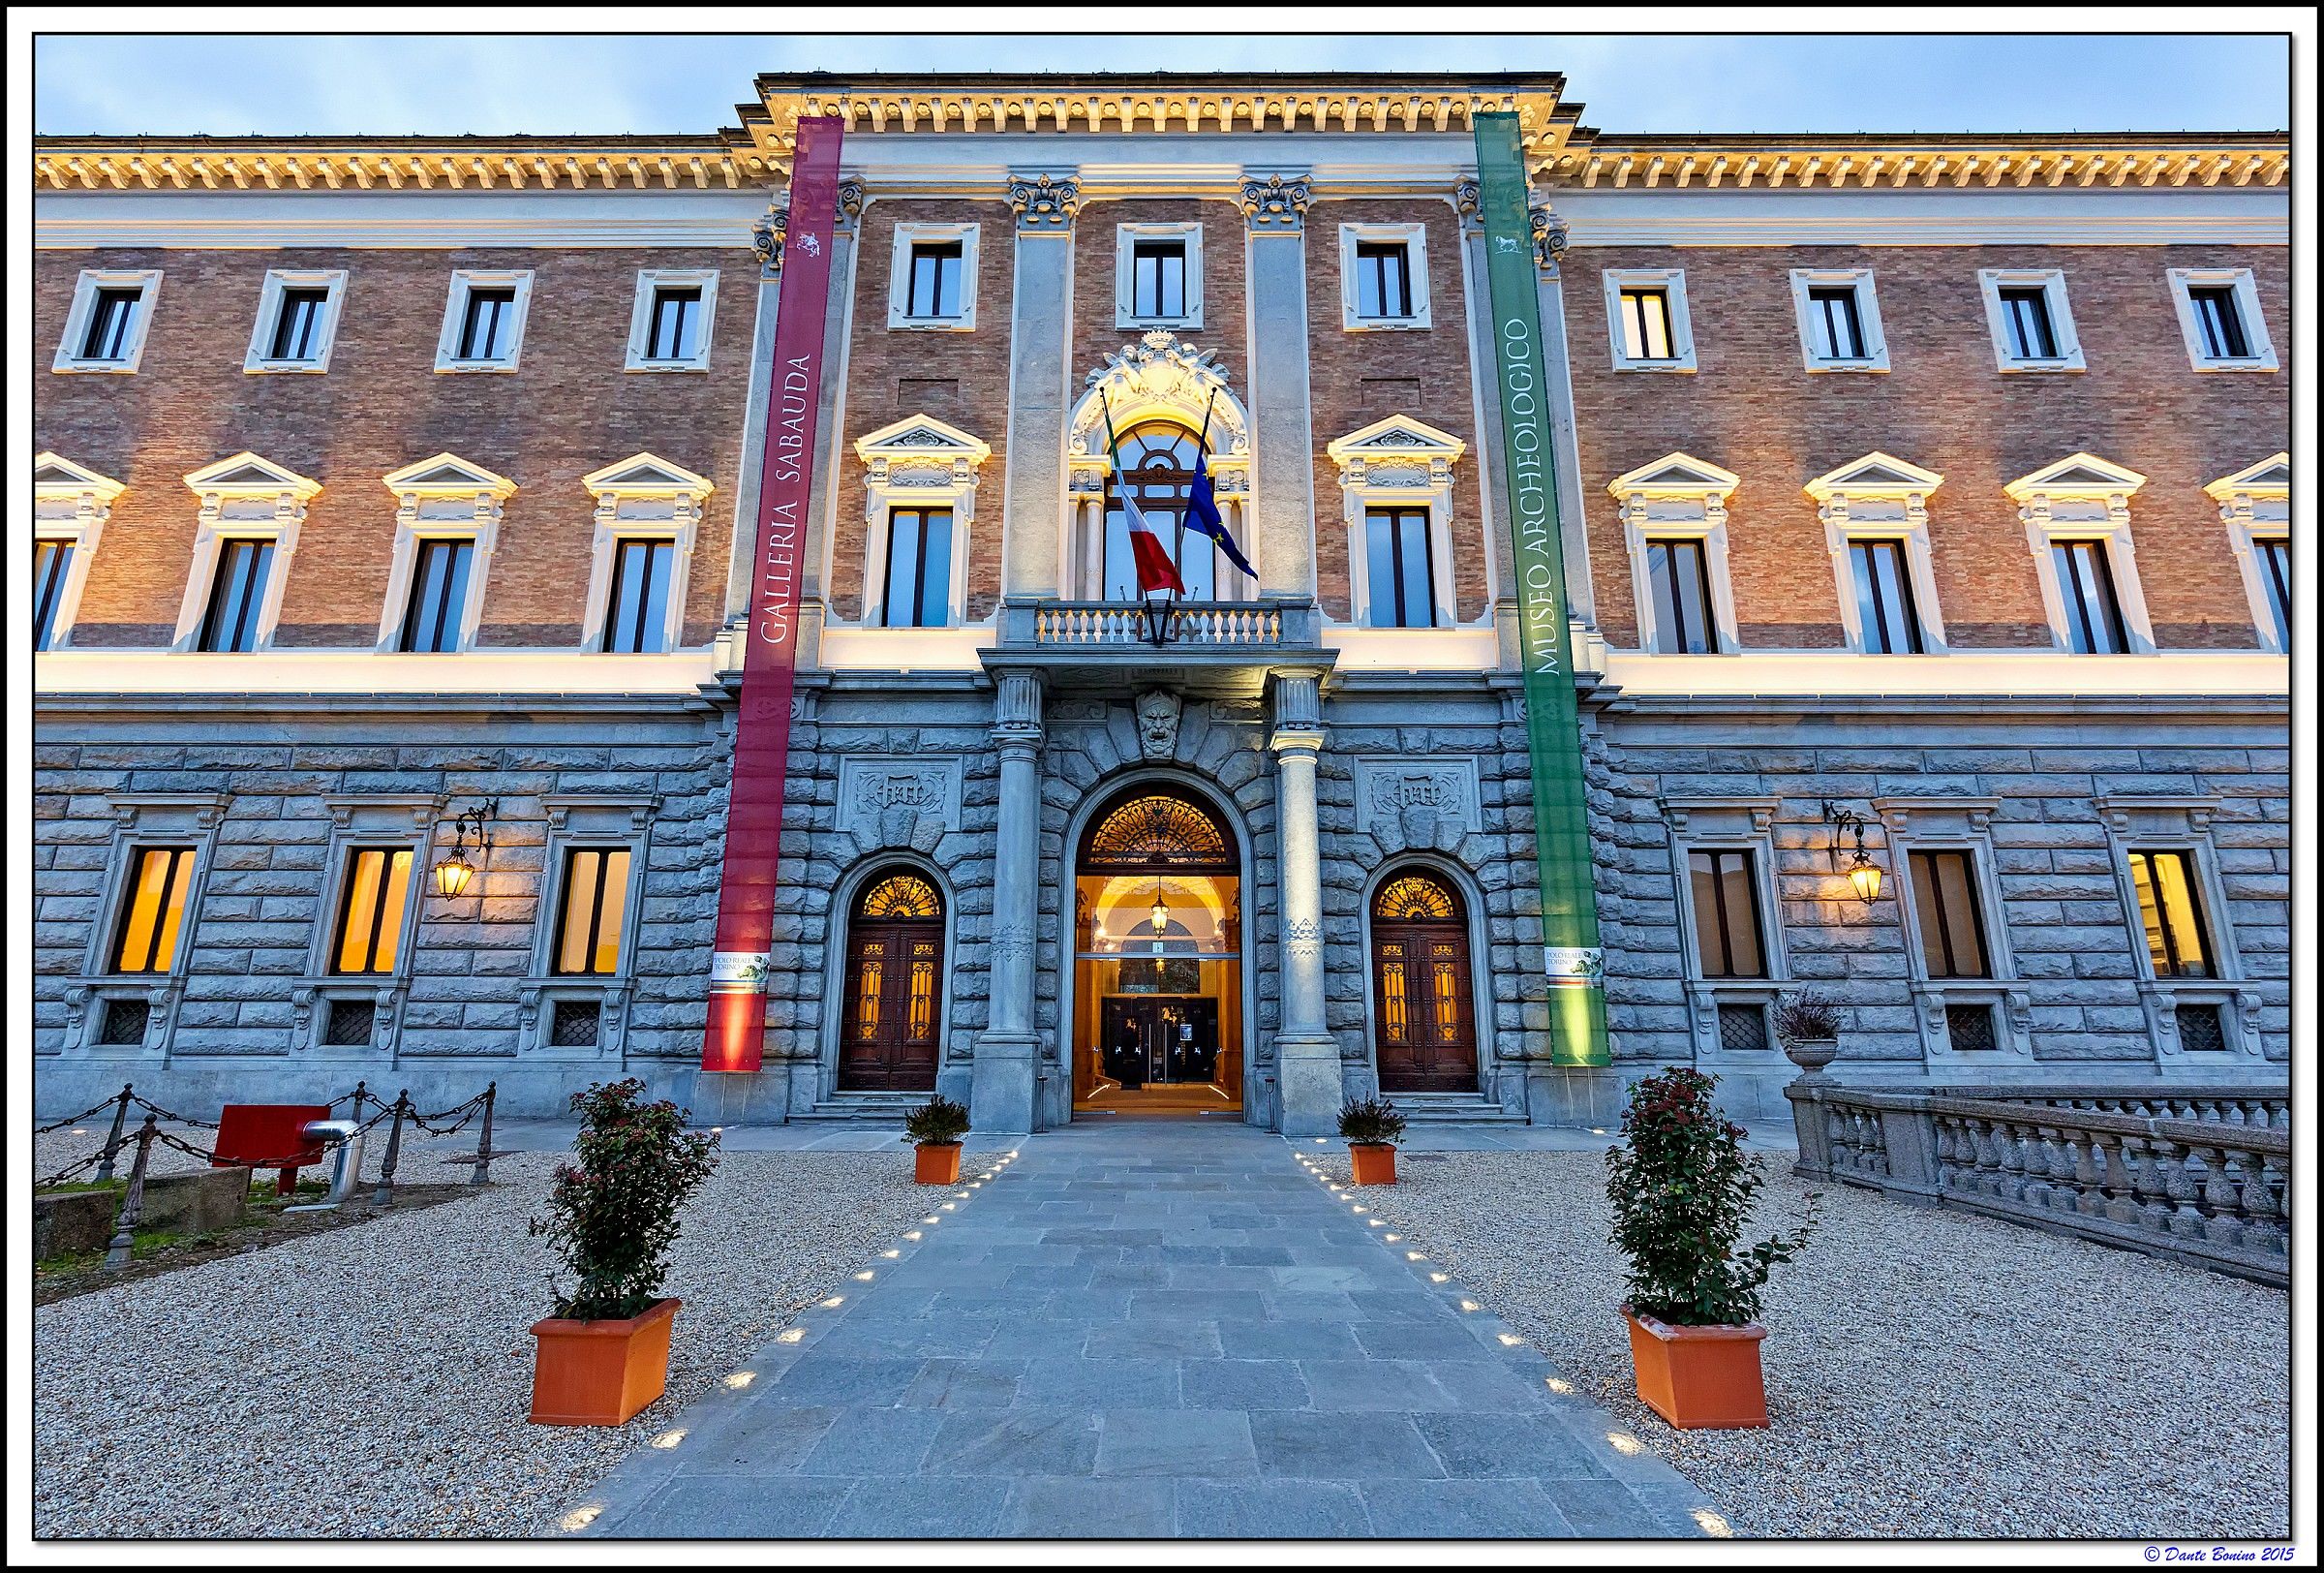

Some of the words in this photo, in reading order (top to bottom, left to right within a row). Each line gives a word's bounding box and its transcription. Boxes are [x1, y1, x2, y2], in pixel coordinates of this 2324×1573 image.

[775, 353, 810, 482] SABAUDA
[1504, 318, 1549, 559] ARCHEOLOGICO
[760, 500, 799, 644] GALLERIA
[1525, 563, 1561, 677] MUSEO
